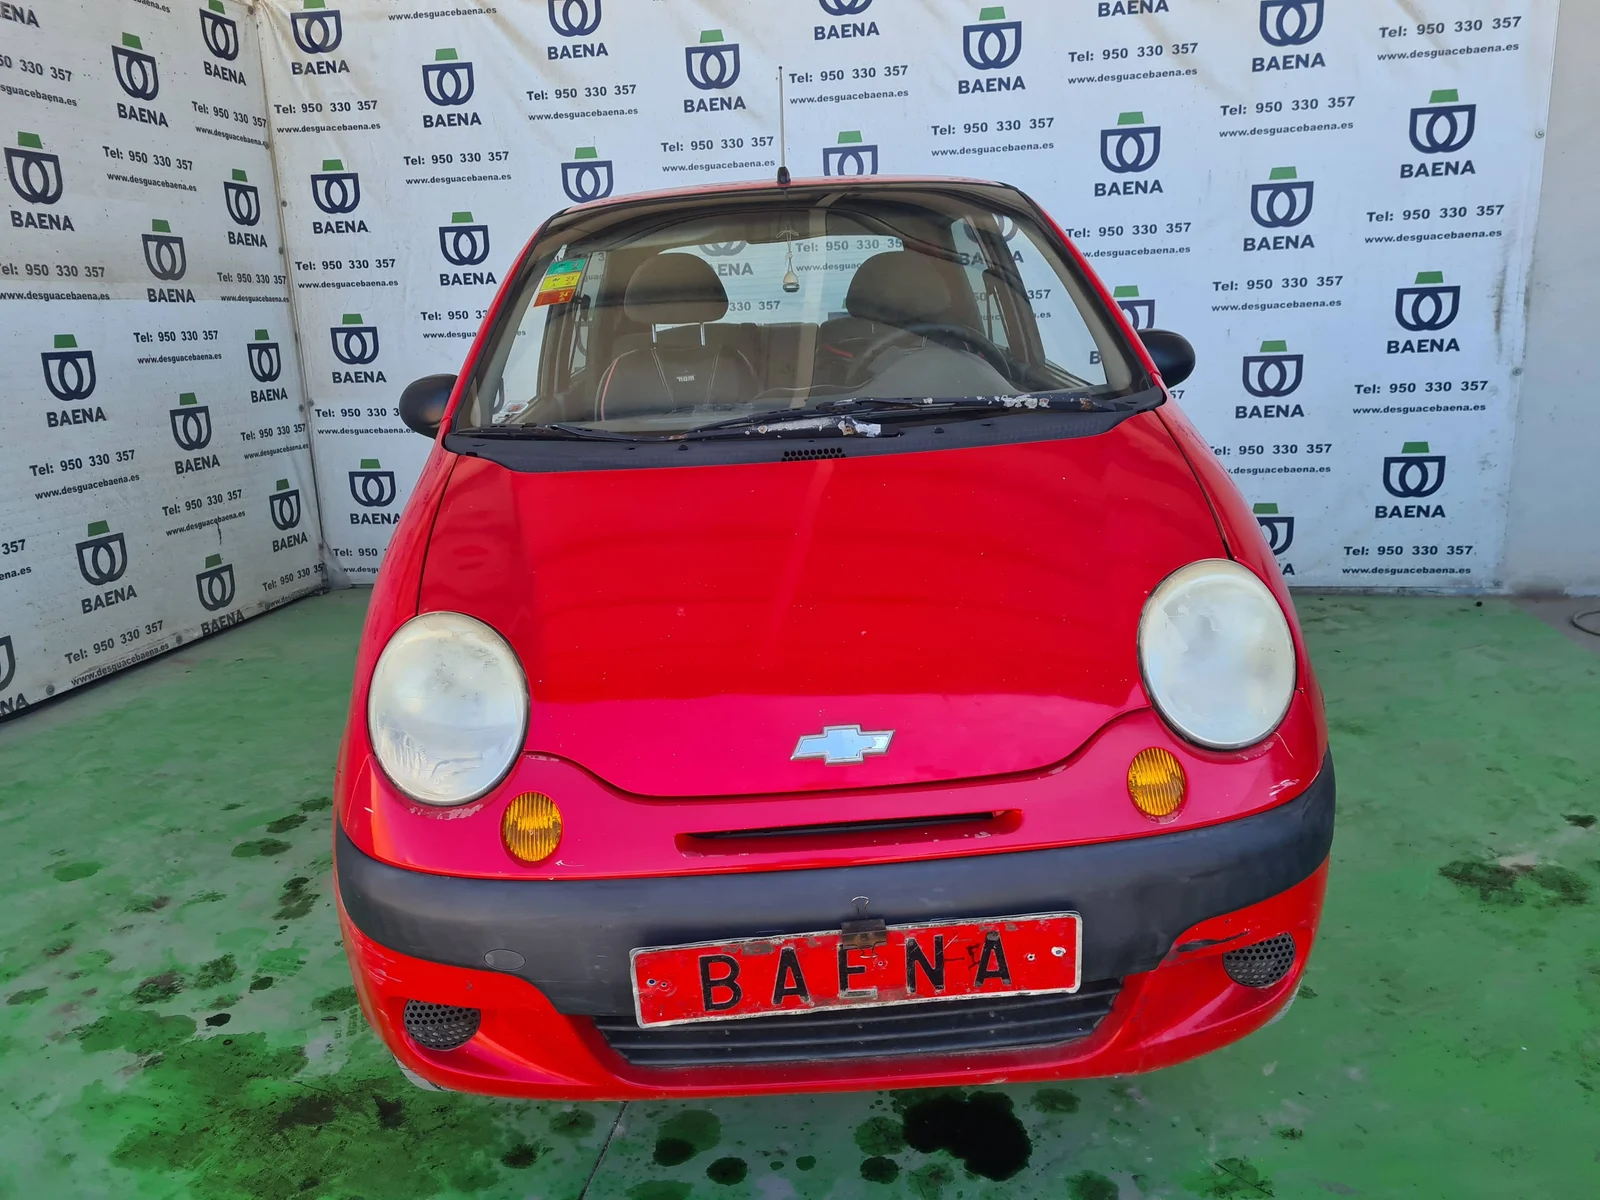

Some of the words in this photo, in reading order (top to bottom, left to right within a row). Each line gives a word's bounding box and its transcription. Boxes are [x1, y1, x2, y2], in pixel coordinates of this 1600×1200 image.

[388, 8, 497, 20] www.desguacebaena.es
[1098, 0, 1169, 18] BAENA
[814, 22, 880, 40] BAENA
[1379, 26, 1407, 38] Tel:
[1417, 23, 1444, 35] 950
[1454, 20, 1482, 32] 330
[1492, 16, 1521, 29] 357
[548, 43, 608, 60] BAENA
[1068, 51, 1093, 62] Tel:
[1103, 48, 1128, 60] 950
[1137, 45, 1163, 57] 330
[1172, 43, 1198, 55] 357
[1377, 44, 1519, 60] www.desguacebaena.es
[291, 60, 350, 75] BAENA
[1252, 53, 1325, 72] BAENA
[203, 61, 246, 86] BAENA
[789, 73, 812, 83] Tel:
[820, 70, 844, 81] 950
[852, 67, 876, 79] 330
[884, 65, 908, 76] 357
[1068, 69, 1197, 84] www.desguacebaena.es
[526, 90, 548, 101] Tel:
[555, 88, 577, 99] 950
[585, 86, 607, 97] 330
[614, 84, 636, 95] 357
[958, 76, 1026, 94] BAENA
[684, 96, 746, 113] BAENA
[790, 91, 908, 104] www.desguacebaena.es
[274, 104, 296, 114] Tel:
[301, 103, 323, 113] 950
[330, 102, 351, 112] 330
[357, 100, 377, 110] 357
[1220, 104, 1246, 116] Tel:
[1256, 101, 1282, 113] 950
[1292, 99, 1318, 110] 330
[1328, 96, 1355, 108] 357
[117, 103, 169, 127] BAENA
[192, 101, 209, 114] Tel:
[213, 106, 229, 119] 950
[233, 111, 248, 124] 330
[252, 116, 266, 128] 357
[423, 112, 482, 128] BAENA
[528, 109, 638, 120] www.desguacebaena.es
[277, 123, 380, 133] www.desguacebaena.es
[931, 125, 955, 135] Tel:
[964, 122, 988, 133] 950
[997, 120, 1021, 131] 330
[1030, 117, 1054, 129] 357
[1219, 123, 1353, 137] www.desguacebaena.es
[661, 142, 683, 152] Tel:
[691, 140, 713, 150] 950
[721, 138, 743, 149] 330
[751, 136, 773, 147] 357
[931, 143, 1054, 156] www.desguacebaena.es
[102, 146, 123, 159] Tel:
[128, 150, 148, 163] 950
[153, 154, 171, 167] 330
[176, 158, 192, 171] 357
[403, 156, 425, 165] Tel:
[432, 154, 453, 164] 950
[460, 153, 481, 163] 330
[488, 151, 509, 161] 357
[662, 161, 775, 171] www.desguacebaena.es
[1400, 160, 1475, 178] BAENA
[107, 173, 197, 191] www.desguacebaena.es
[406, 174, 511, 184] www.desguacebaena.es
[1095, 180, 1163, 197] BAENA
[10, 210, 75, 231] BAENA
[1367, 211, 1393, 222] Tel:
[1403, 209, 1430, 220] 950
[1440, 207, 1467, 218] 330
[1477, 205, 1504, 216] 357
[312, 220, 368, 234] BAENA
[1066, 228, 1090, 238] Tel:
[1099, 226, 1123, 237] 950
[1133, 224, 1157, 235] 330
[1166, 222, 1191, 233] 357
[228, 231, 268, 247] BAENA
[1243, 235, 1314, 251] BAENA
[1365, 231, 1502, 243] www.desguacebaena.es
[796, 243, 818, 252] Tel:
[826, 241, 848, 251] 950
[857, 240, 879, 249] 330
[295, 261, 316, 271] Tel:
[322, 260, 342, 270] 950
[349, 260, 369, 269] 330
[375, 259, 395, 268] 357
[217, 272, 233, 282] Tel:
[237, 273, 252, 283] 950
[256, 274, 270, 284] 330
[273, 275, 286, 284] 357
[298, 280, 398, 289] www.desguacebaena.es
[440, 272, 497, 286] BAENA
[1213, 281, 1238, 291] Tel:
[1247, 279, 1273, 290] 950
[1282, 277, 1307, 288] 330
[1317, 276, 1343, 286] 357
[147, 288, 195, 303] BAENA
[1212, 301, 1341, 311] www.desguacebaena.es
[133, 332, 153, 343] Tel:
[158, 331, 176, 342] 950
[181, 331, 198, 341] 330
[203, 330, 218, 340] 357
[1387, 338, 1460, 354] BAENA
[137, 353, 222, 364] www.desguacebaena.es
[332, 371, 387, 383] BAENA
[251, 388, 288, 403] BAENA
[1354, 384, 1380, 394] Tel:
[1390, 383, 1416, 393] 950
[1425, 382, 1452, 392] 330
[1461, 381, 1488, 391] 357
[46, 407, 107, 427] BAENA
[315, 409, 335, 417] Tel:
[341, 408, 361, 417] 950
[367, 408, 387, 417] 330
[1235, 404, 1304, 419] BAENA
[1353, 404, 1486, 414] www.desguacebaena.es
[240, 431, 255, 441] Tel:
[259, 428, 273, 438] 950
[277, 425, 290, 435] 330
[294, 423, 305, 433] 357
[244, 443, 309, 459] www.desguacebaena.es
[1239, 445, 1264, 455] 950
[1272, 444, 1298, 454] 330
[1306, 444, 1332, 453] 357
[29, 463, 54, 476] Tel:
[60, 458, 82, 471] 950
[89, 454, 110, 466] 330
[116, 449, 134, 462] 357
[175, 454, 220, 475] BAENA
[35, 475, 140, 499] www.desguacebaena.es
[162, 504, 180, 516] Tel:
[185, 499, 202, 511] 950
[207, 494, 225, 506] 330
[227, 489, 242, 501] 357
[1375, 505, 1446, 518] BAENA
[166, 511, 246, 536] www.desguacebaena.es
[272, 532, 308, 552] BAENA
[1344, 546, 1369, 555] Tel:
[1377, 546, 1403, 555] 950
[1412, 546, 1438, 555] 330
[1446, 546, 1473, 555] 357
[1342, 567, 1471, 575] www.desguacebaena.es
[81, 585, 137, 614] BAENA
[64, 649, 88, 664] Tel:
[93, 638, 114, 654] 950
[120, 629, 140, 646] 330
[145, 620, 163, 635] 357
[71, 643, 170, 687] www.desguacebaena.es
[699, 931, 1011, 1011] BAENA
